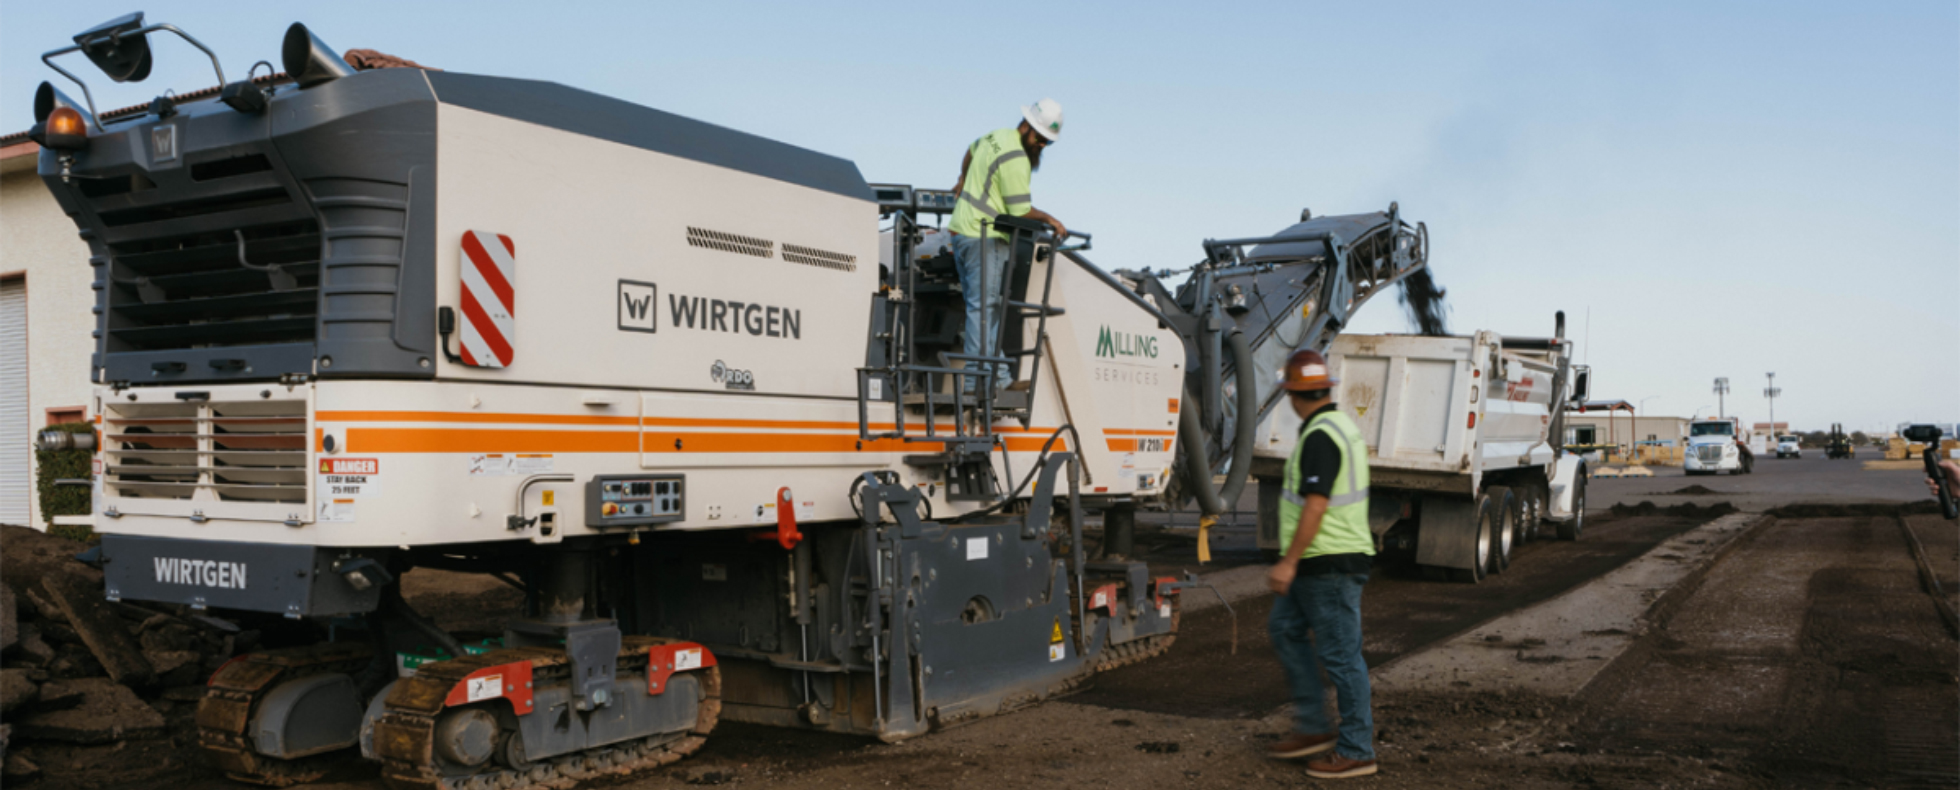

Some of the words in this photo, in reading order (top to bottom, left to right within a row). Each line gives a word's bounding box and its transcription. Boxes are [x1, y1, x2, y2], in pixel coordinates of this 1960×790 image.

[668, 293, 801, 340] WIRTGEN
[1096, 324, 1158, 358] MILLING
[725, 369, 753, 385] RDO
[1095, 367, 1158, 385] SERVICES
[1138, 438, 1147, 452] W
[333, 460, 376, 473] DANGER
[326, 475, 343, 484] STAY
[345, 475, 367, 484] BACK
[332, 486, 342, 494] 25
[343, 486, 360, 494] FEET
[153, 557, 246, 589] WIRTGEN
